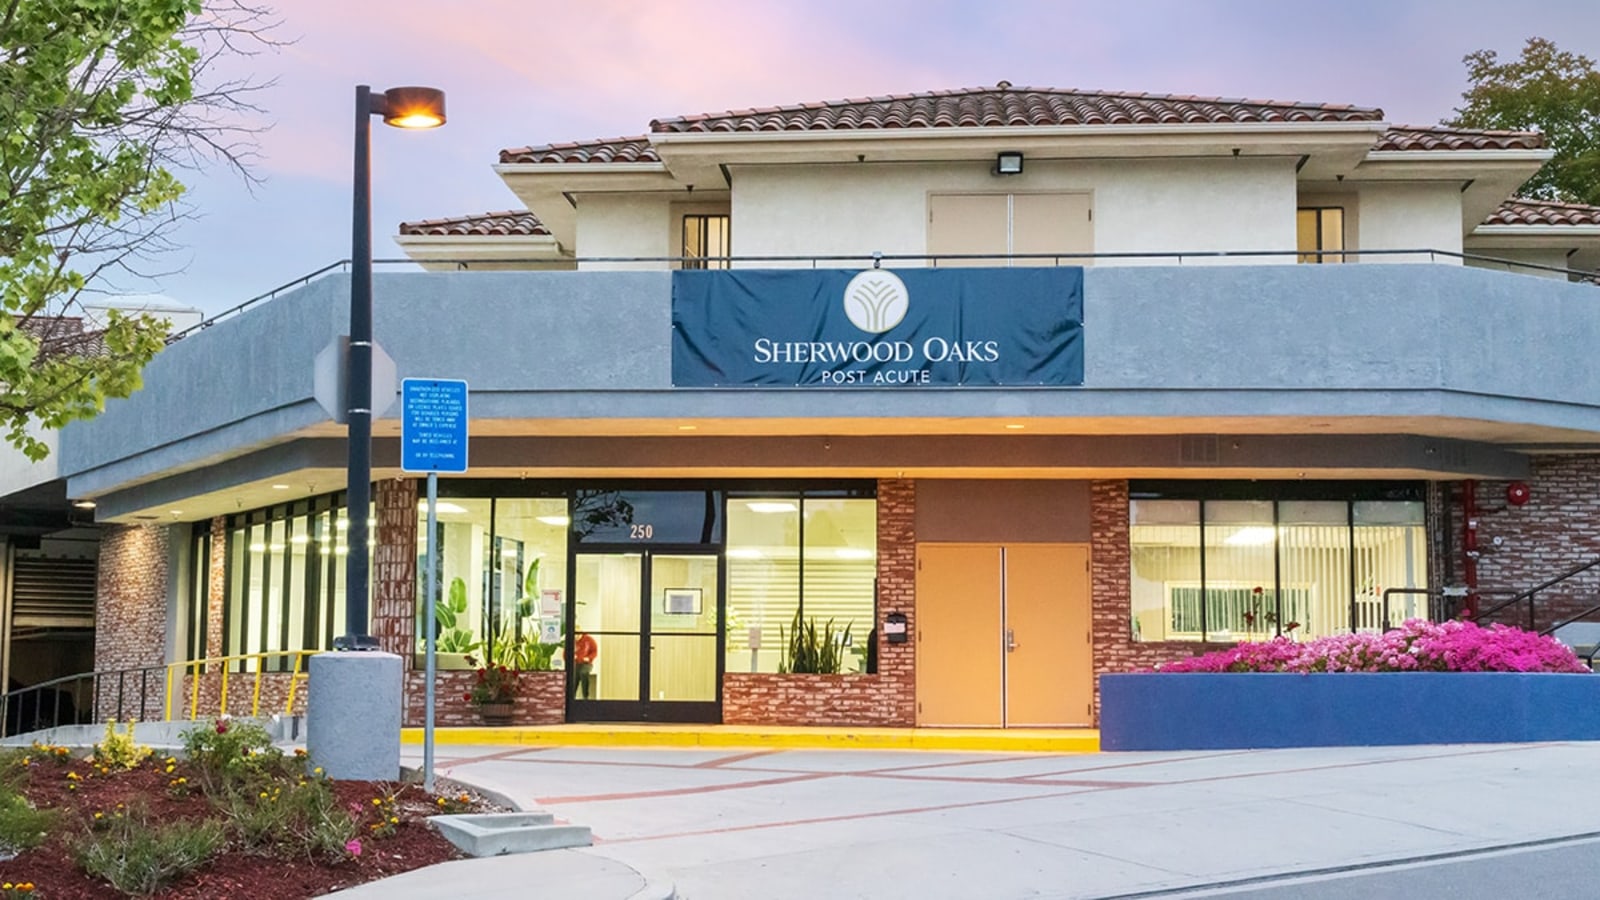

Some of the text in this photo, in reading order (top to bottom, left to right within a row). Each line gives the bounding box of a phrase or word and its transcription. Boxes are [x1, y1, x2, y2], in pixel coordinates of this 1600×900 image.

[754, 337, 999, 363] SHERWOOD OAKS
[822, 370, 930, 384] POST ACUTE
[630, 524, 653, 538] 250
